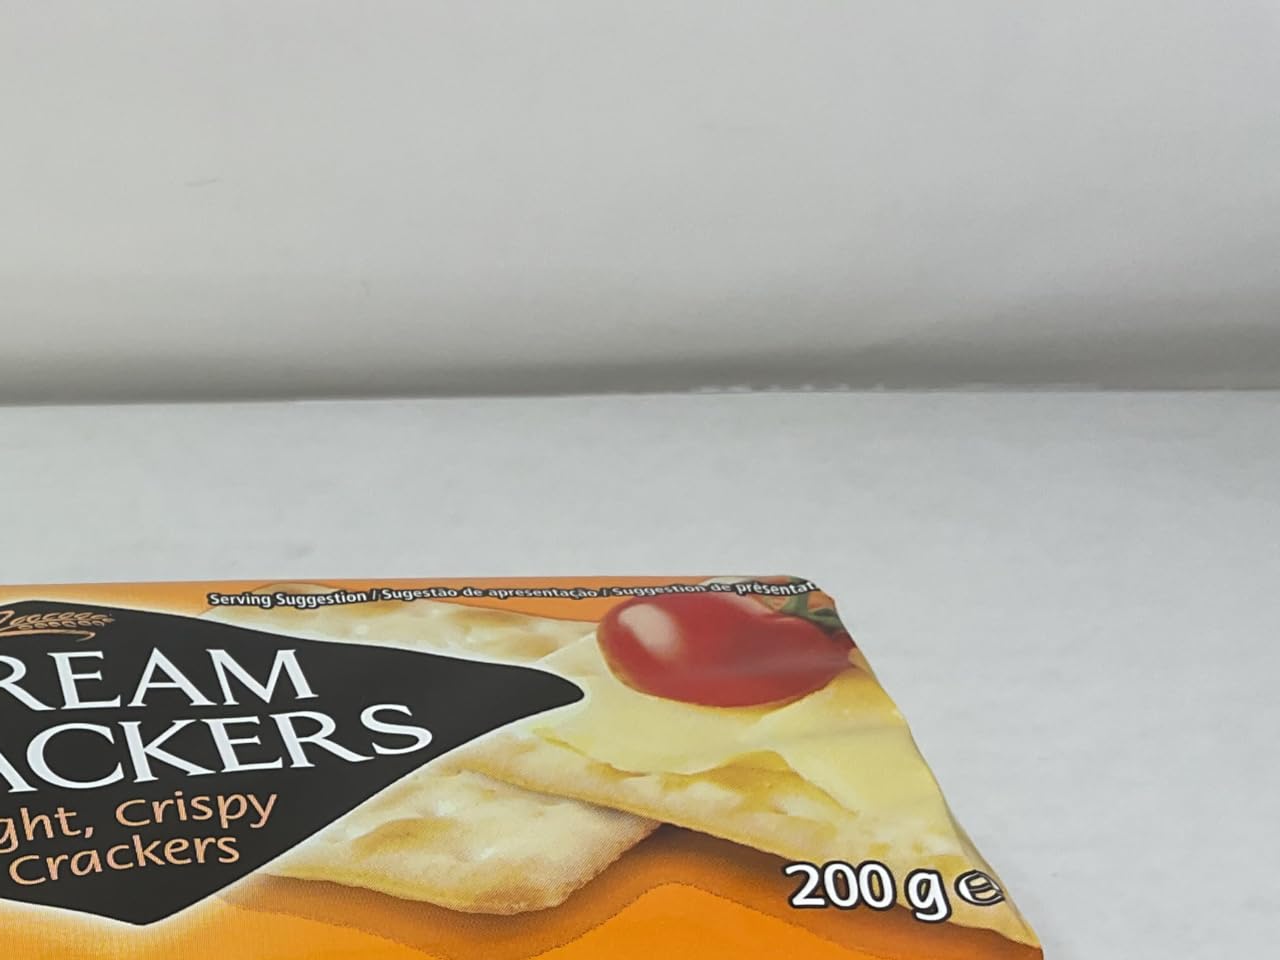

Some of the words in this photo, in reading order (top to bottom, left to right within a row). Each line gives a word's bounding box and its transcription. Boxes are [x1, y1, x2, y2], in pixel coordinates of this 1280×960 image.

[209, 593, 270, 607] Serving
[276, 591, 367, 608] Suggestion
[383, 588, 458, 602] Sugestão
[463, 586, 483, 598] de
[488, 586, 597, 600] apresentação
[613, 583, 707, 597] Suggestion
[710, 582, 733, 594] de
[115, 792, 278, 829] Crispy
[8, 833, 241, 886] Crackers
[784, 862, 895, 910] 200
[906, 871, 950, 922] g
